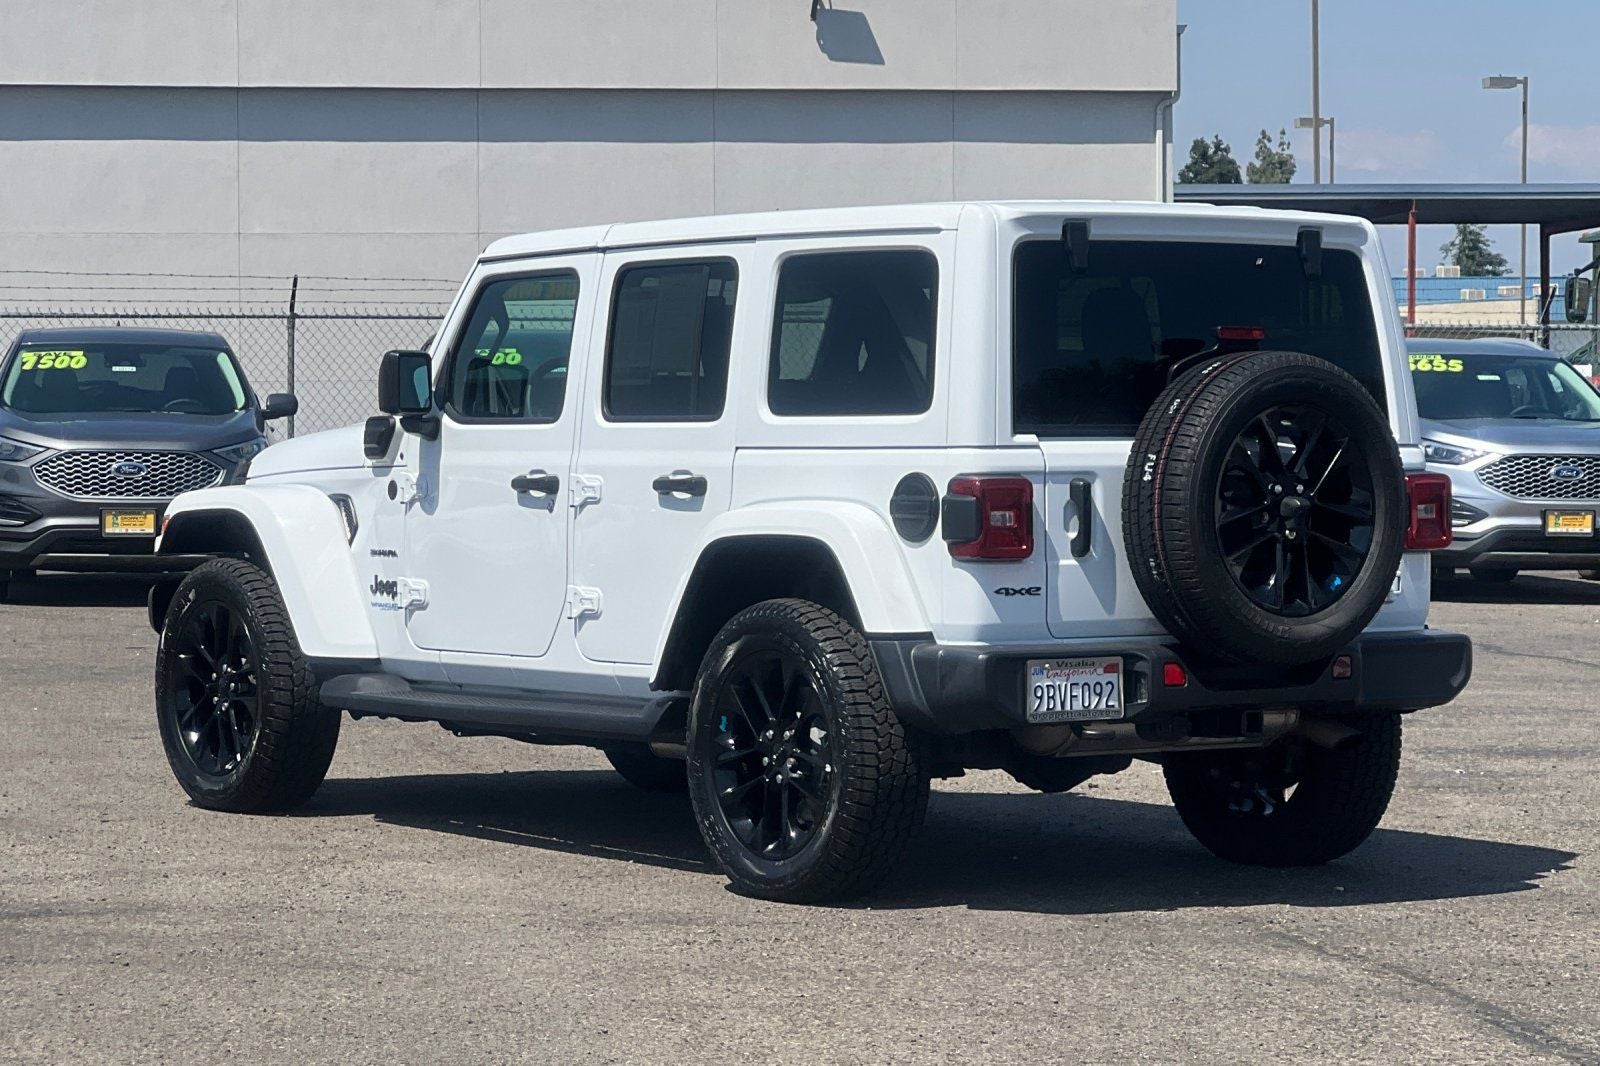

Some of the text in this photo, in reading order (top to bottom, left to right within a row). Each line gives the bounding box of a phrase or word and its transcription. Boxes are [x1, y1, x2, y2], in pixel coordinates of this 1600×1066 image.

[369, 574, 398, 602] Jeep
[1056, 659, 1097, 669] Visalia
[1031, 667, 1045, 677] JUN
[1046, 667, 1099, 681] California
[1033, 680, 1116, 712] 9BVF092
